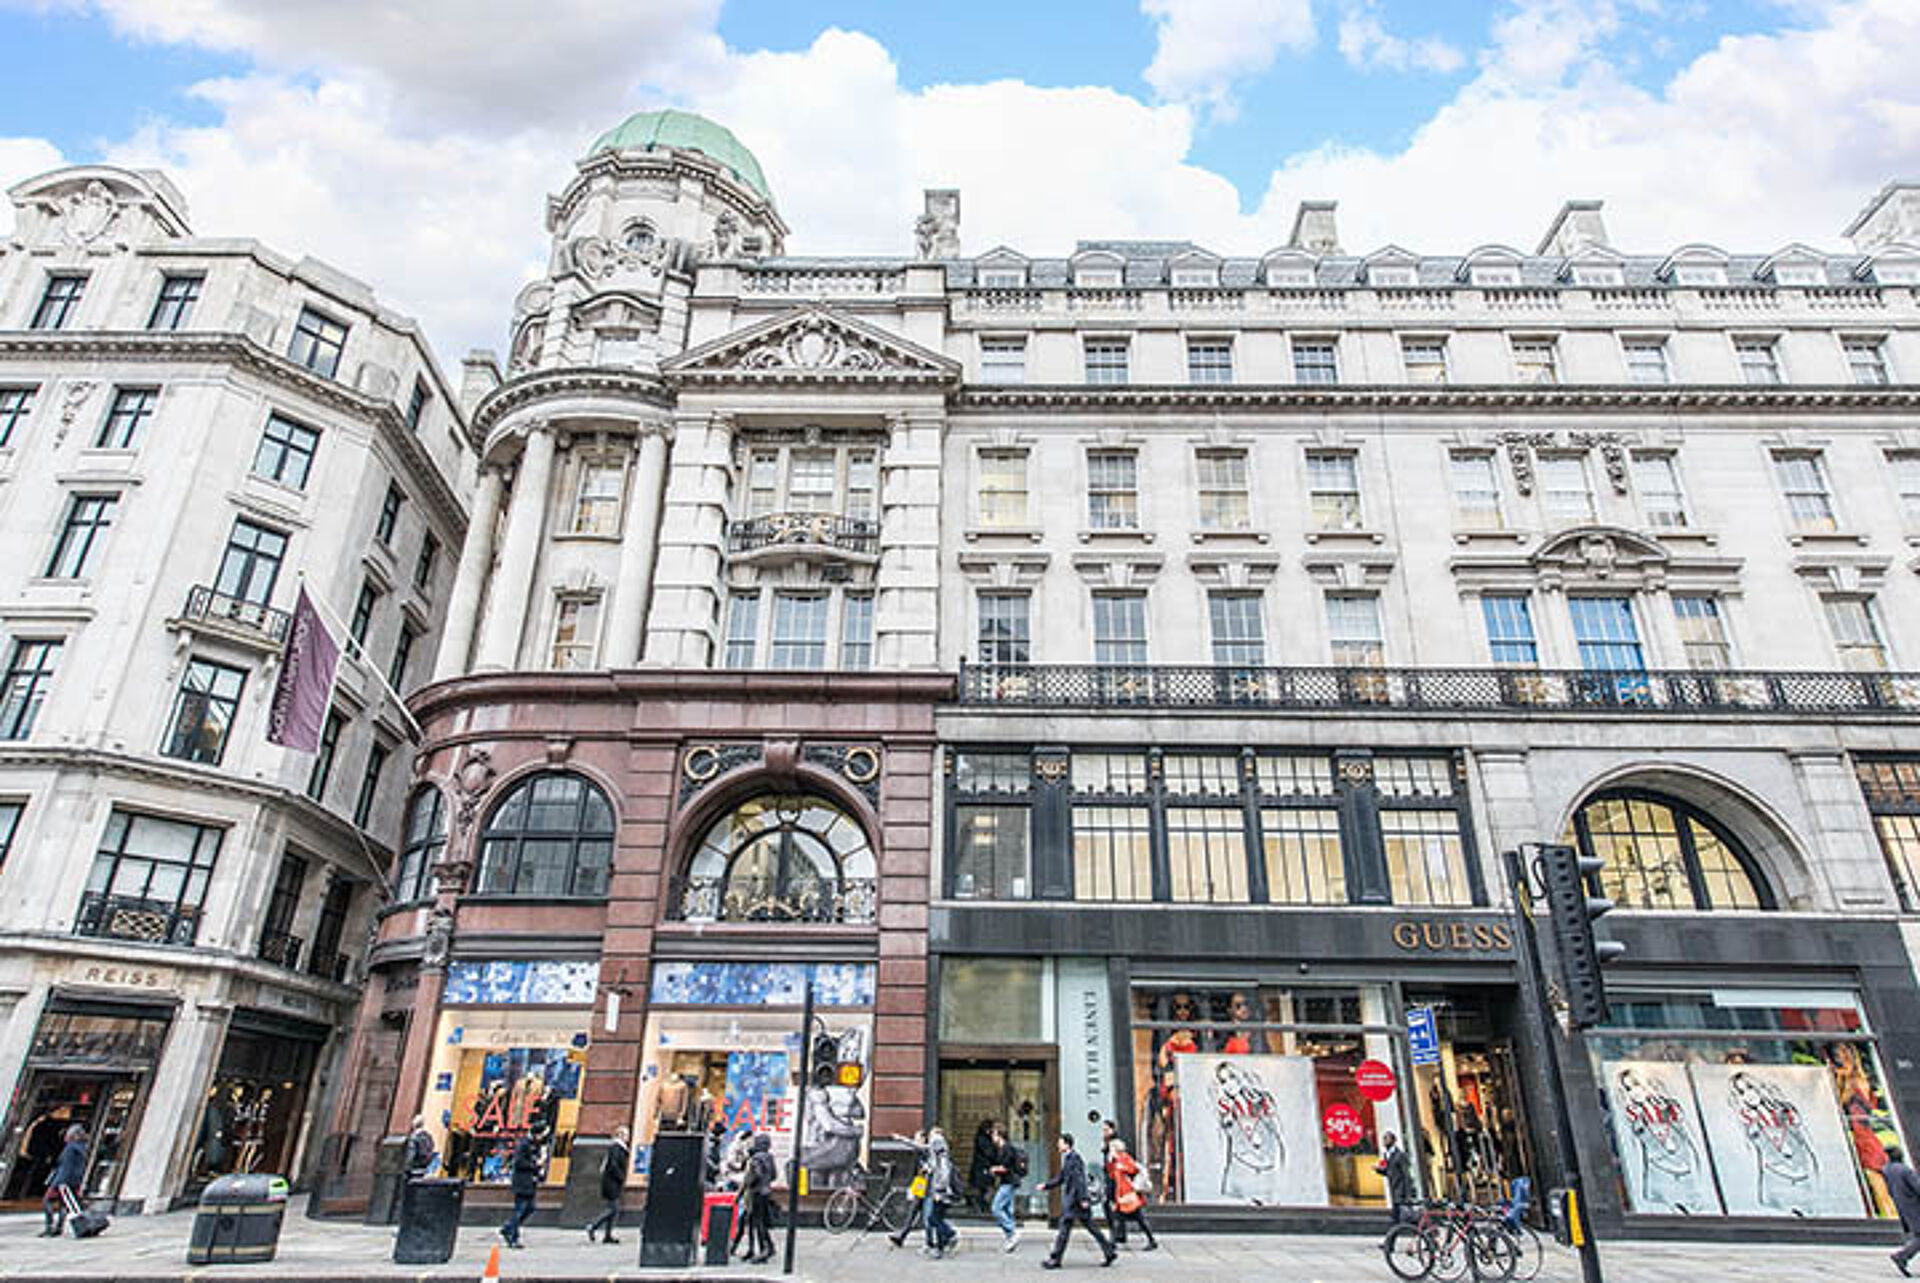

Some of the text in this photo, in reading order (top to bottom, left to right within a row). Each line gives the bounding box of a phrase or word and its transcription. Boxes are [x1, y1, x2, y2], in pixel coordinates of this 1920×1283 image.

[1394, 921, 1514, 950] GUESS
[85, 967, 158, 986] REISS
[460, 1093, 543, 1130] SALE
[709, 1097, 792, 1132] SALE
[1218, 1098, 1274, 1119] SALE
[1327, 1117, 1363, 1134] 50%
